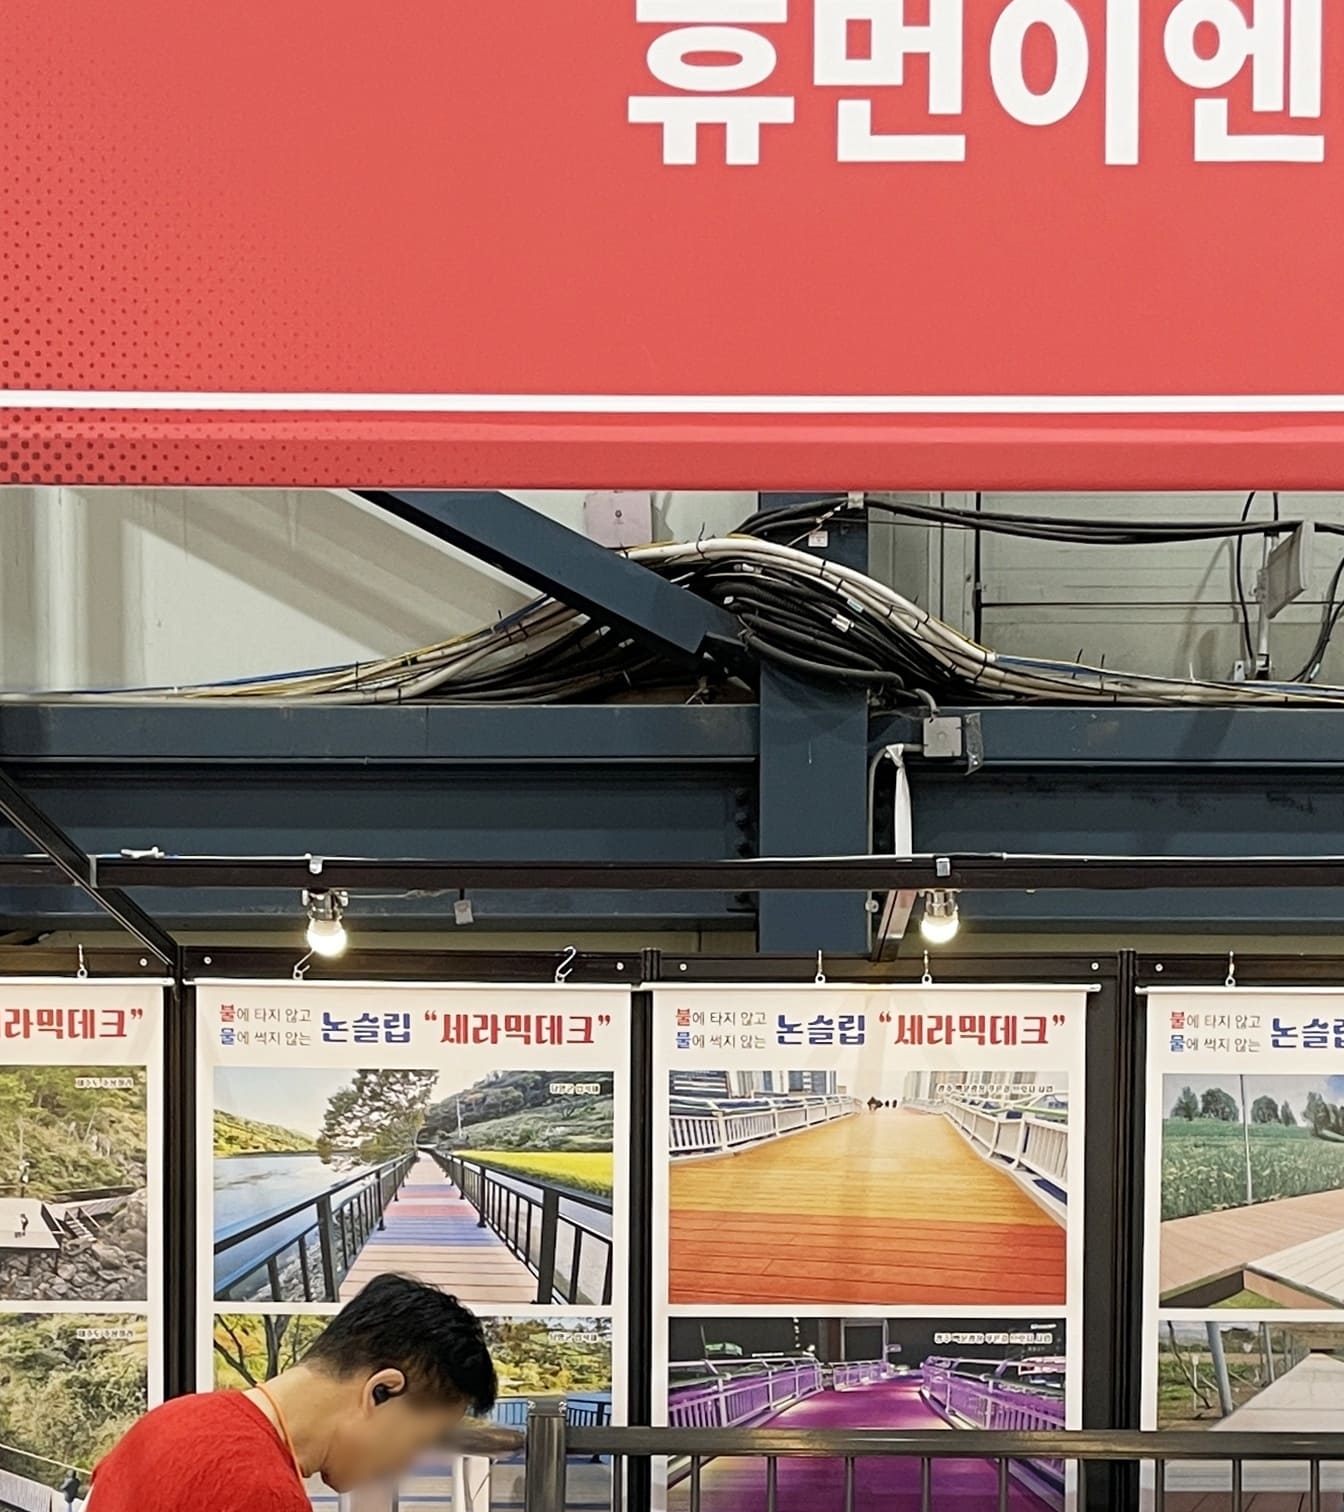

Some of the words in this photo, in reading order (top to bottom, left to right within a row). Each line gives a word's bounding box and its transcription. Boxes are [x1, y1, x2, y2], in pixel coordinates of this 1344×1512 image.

[253, 1008, 281, 1022] 타지
[710, 1011, 736, 1026] 타지
[1204, 1013, 1231, 1029] 타지
[321, 1012, 411, 1044] 논슬립
[776, 1013, 866, 1046] 논슬립
